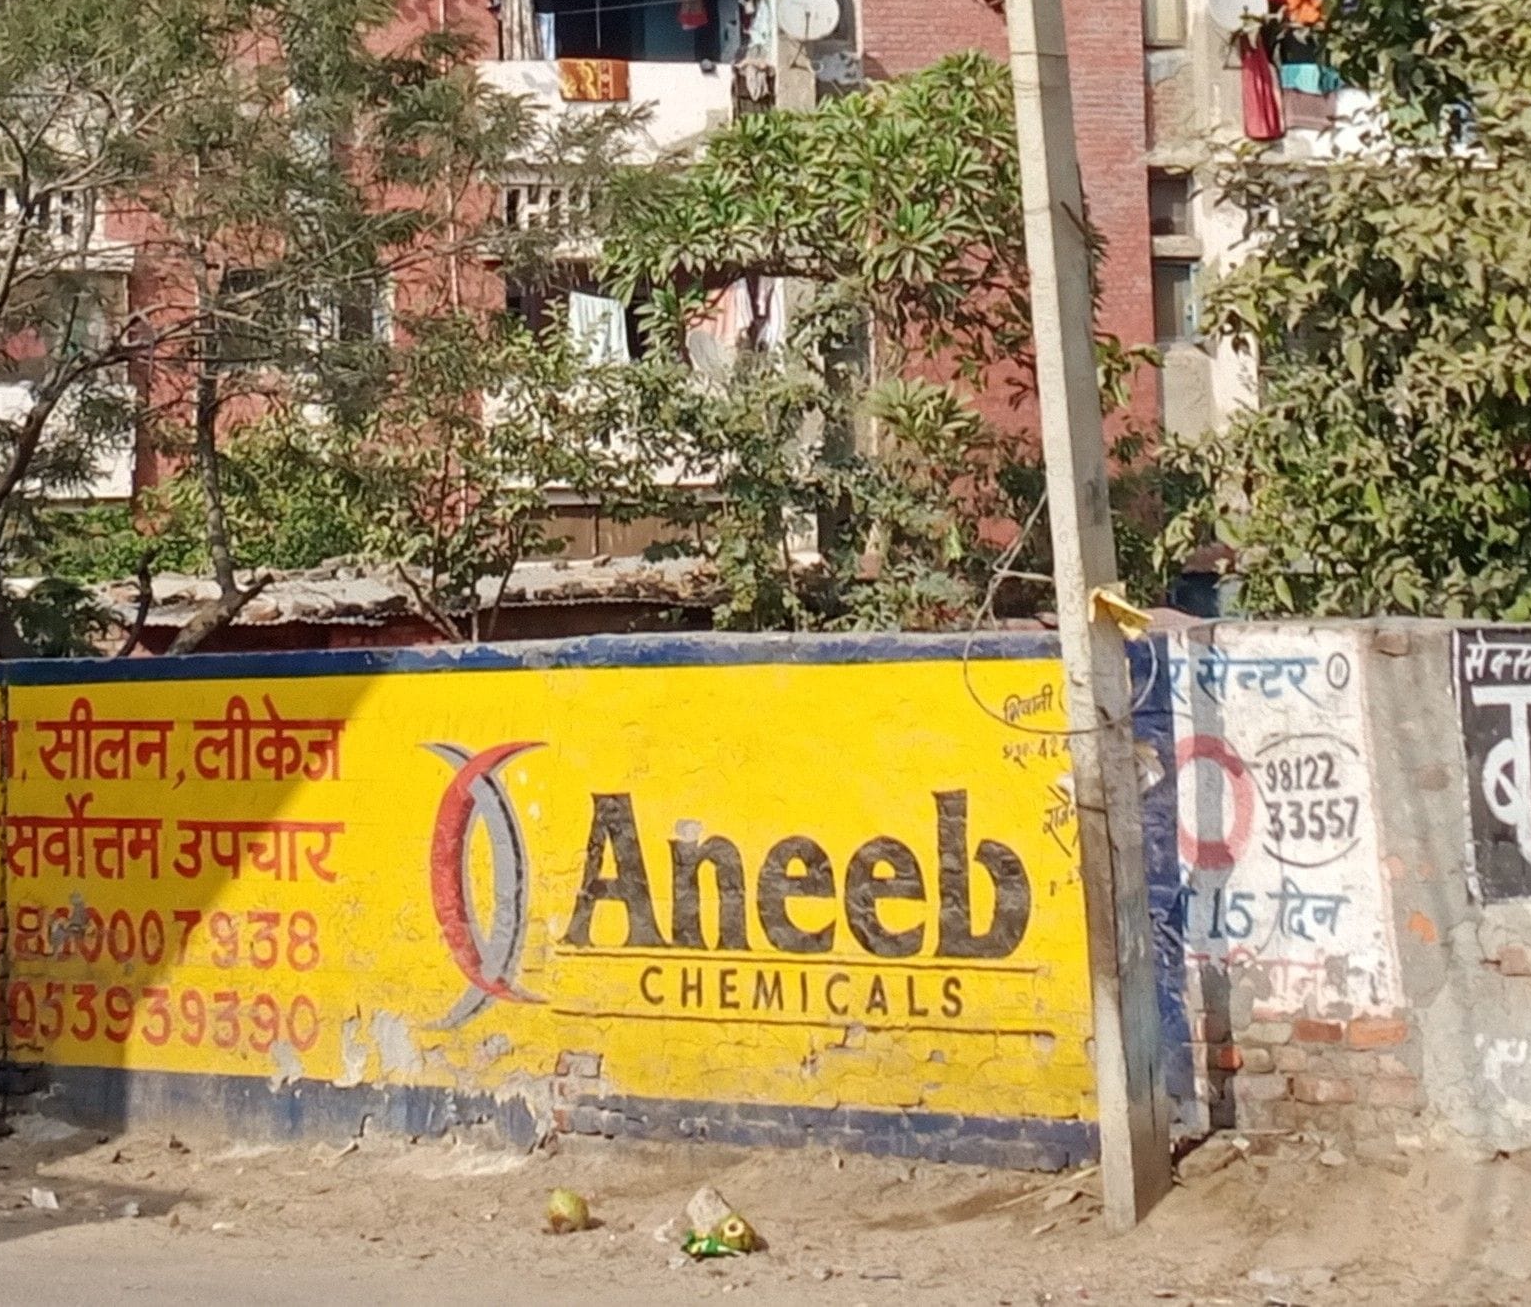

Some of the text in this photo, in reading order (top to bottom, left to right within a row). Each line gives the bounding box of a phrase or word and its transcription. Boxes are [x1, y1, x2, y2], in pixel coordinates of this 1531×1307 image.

[194, 693, 346, 781] लीकेज
[1265, 751, 1341, 793] 98122
[1265, 797, 1360, 841] 33557
[173, 822, 344, 883] उपचार
[564, 790, 1030, 959] Aneeb
[1209, 889, 1254, 939] 15
[639, 965, 965, 1019] CHEMICALS
